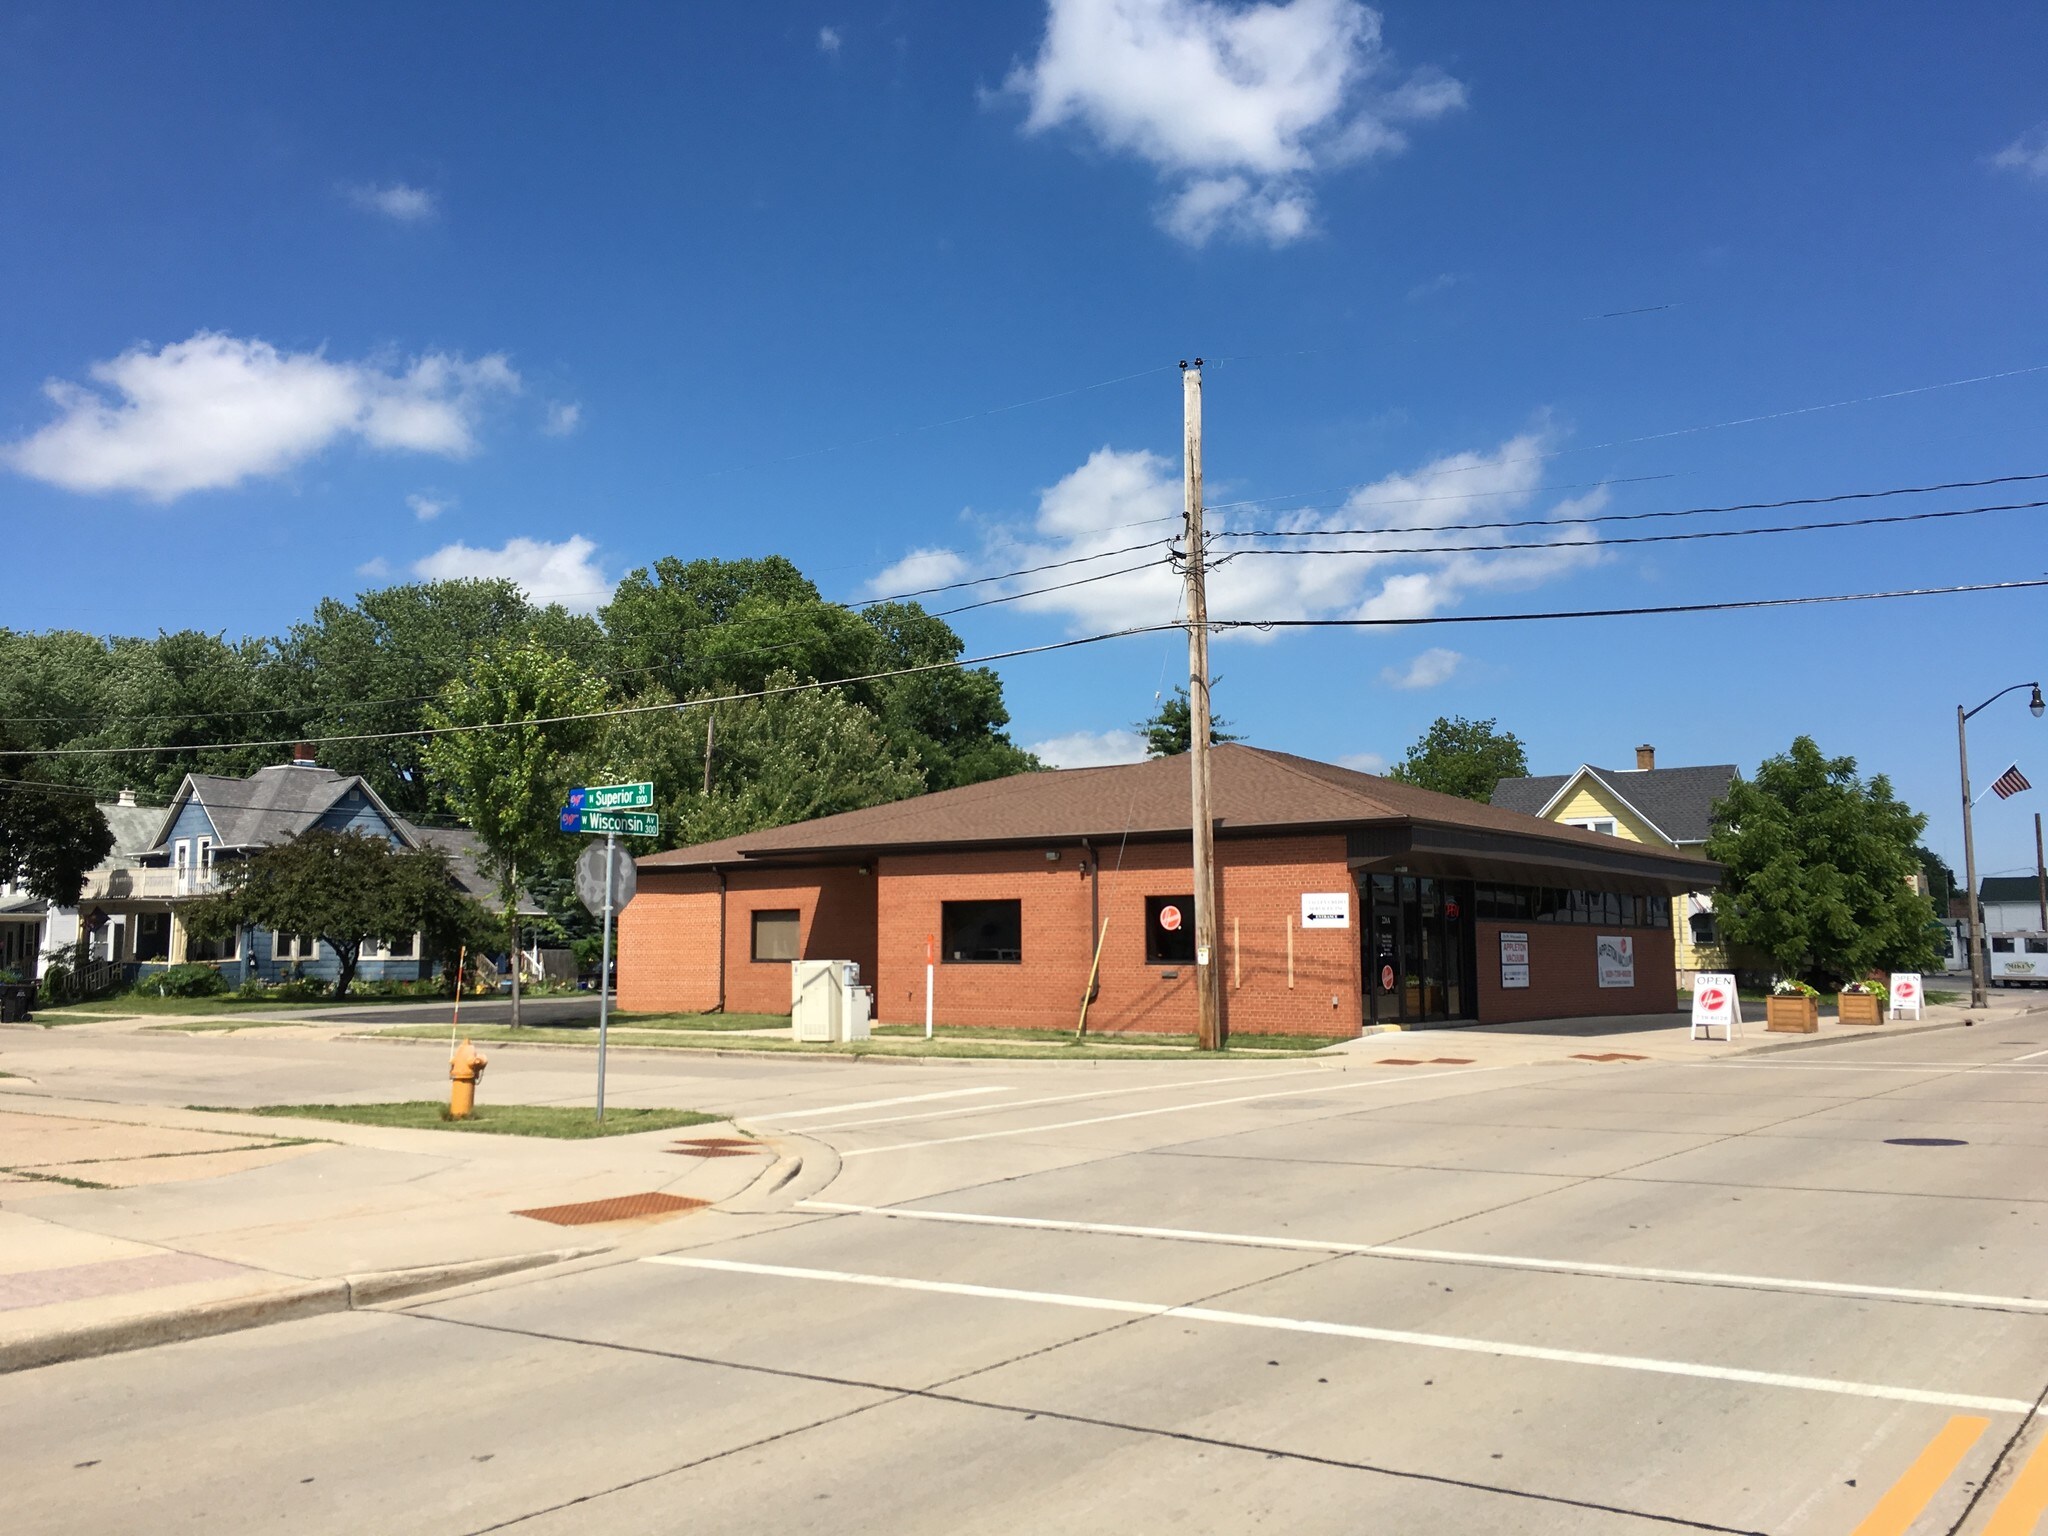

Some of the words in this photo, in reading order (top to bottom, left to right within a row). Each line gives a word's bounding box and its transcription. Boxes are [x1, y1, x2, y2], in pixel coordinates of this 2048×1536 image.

[638, 785, 646, 794] St
[589, 795, 594, 803] N
[595, 789, 634, 807] Superior
[636, 795, 648, 804] 1300
[581, 816, 588, 825] W
[589, 812, 643, 832] Wisconsin
[646, 815, 655, 824] Av
[644, 825, 657, 834] 300
[1503, 943, 1527, 951] APPLETON
[1505, 954, 1525, 963] VACUUM
[1696, 976, 1732, 985] OPEN
